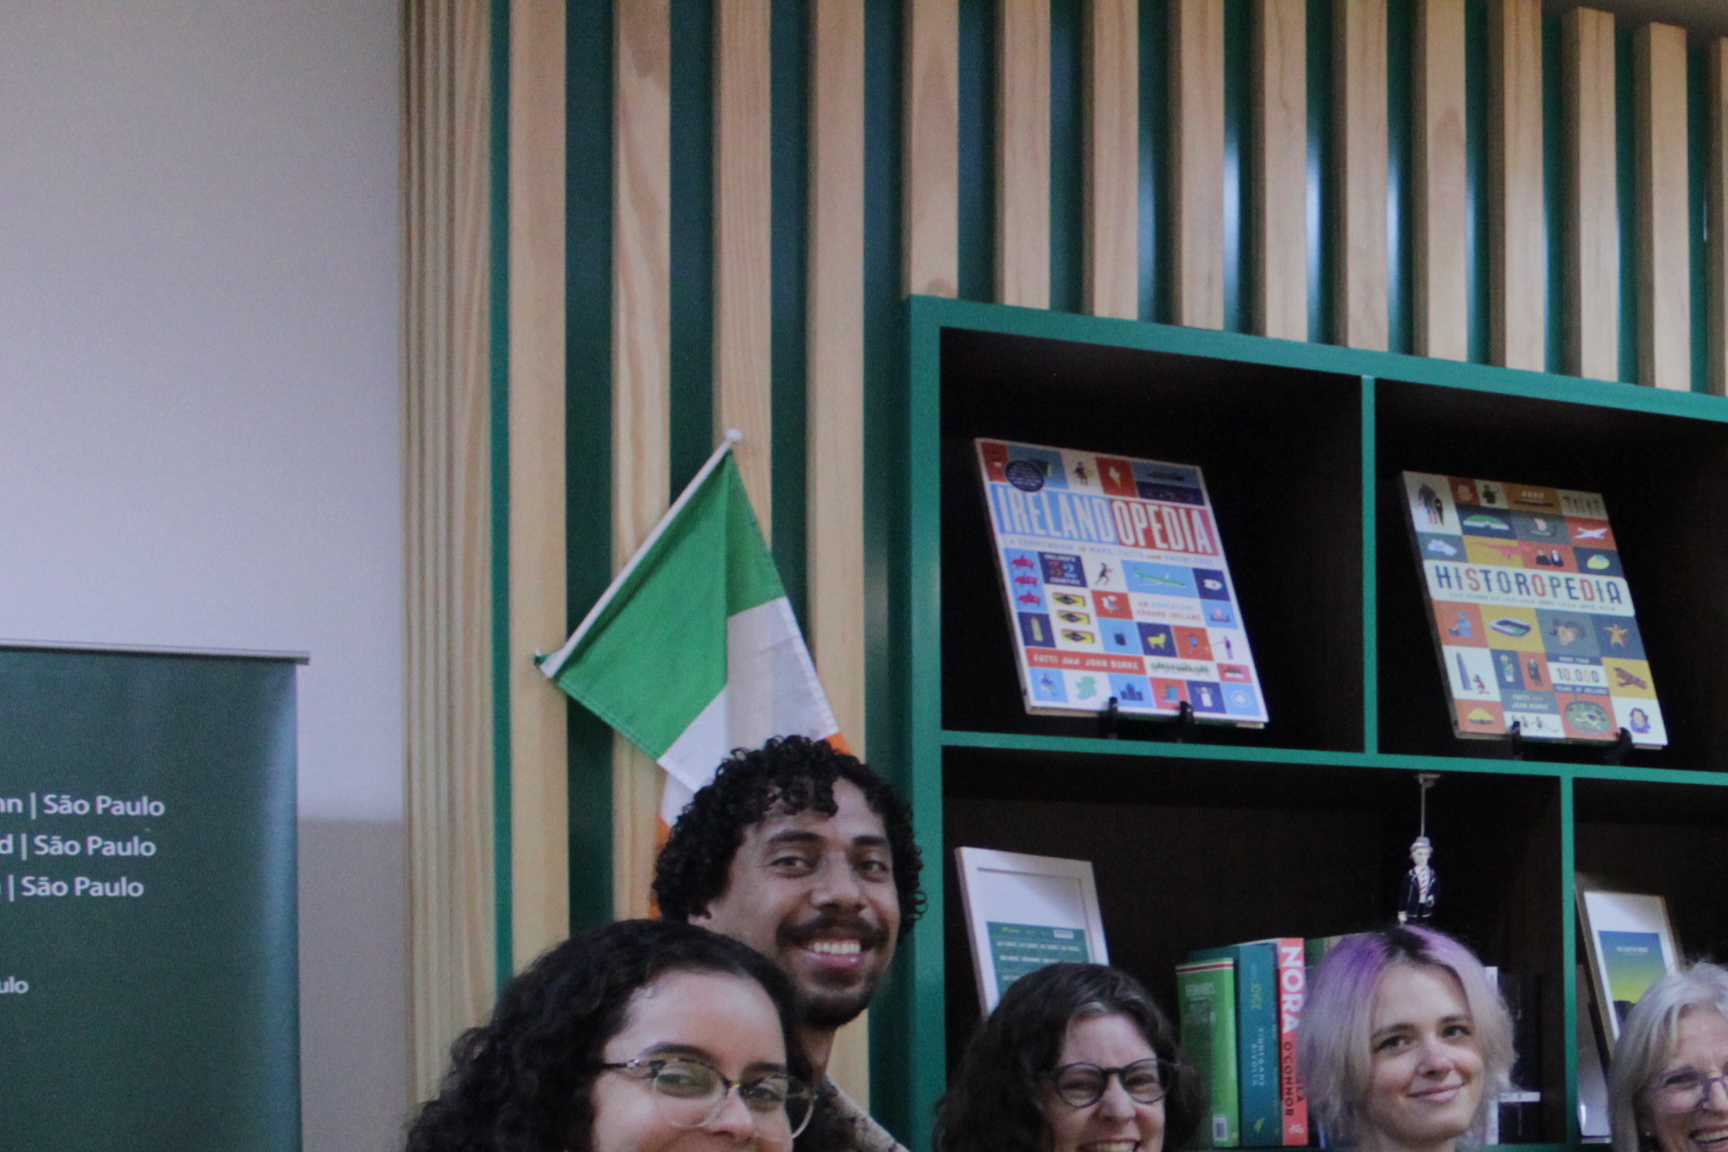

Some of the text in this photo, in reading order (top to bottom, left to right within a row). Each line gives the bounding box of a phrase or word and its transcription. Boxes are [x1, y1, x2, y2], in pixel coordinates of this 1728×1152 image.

[1434, 564, 1623, 605] HISTOROPEDIA
[43, 794, 90, 816] São
[96, 796, 165, 816] Paulo
[34, 835, 81, 856] São
[87, 836, 156, 857] Paulo
[21, 877, 144, 897] São Paulo
[1281, 946, 1304, 1034] NORA
[1283, 1041, 1294, 1117] O'CONNOR
